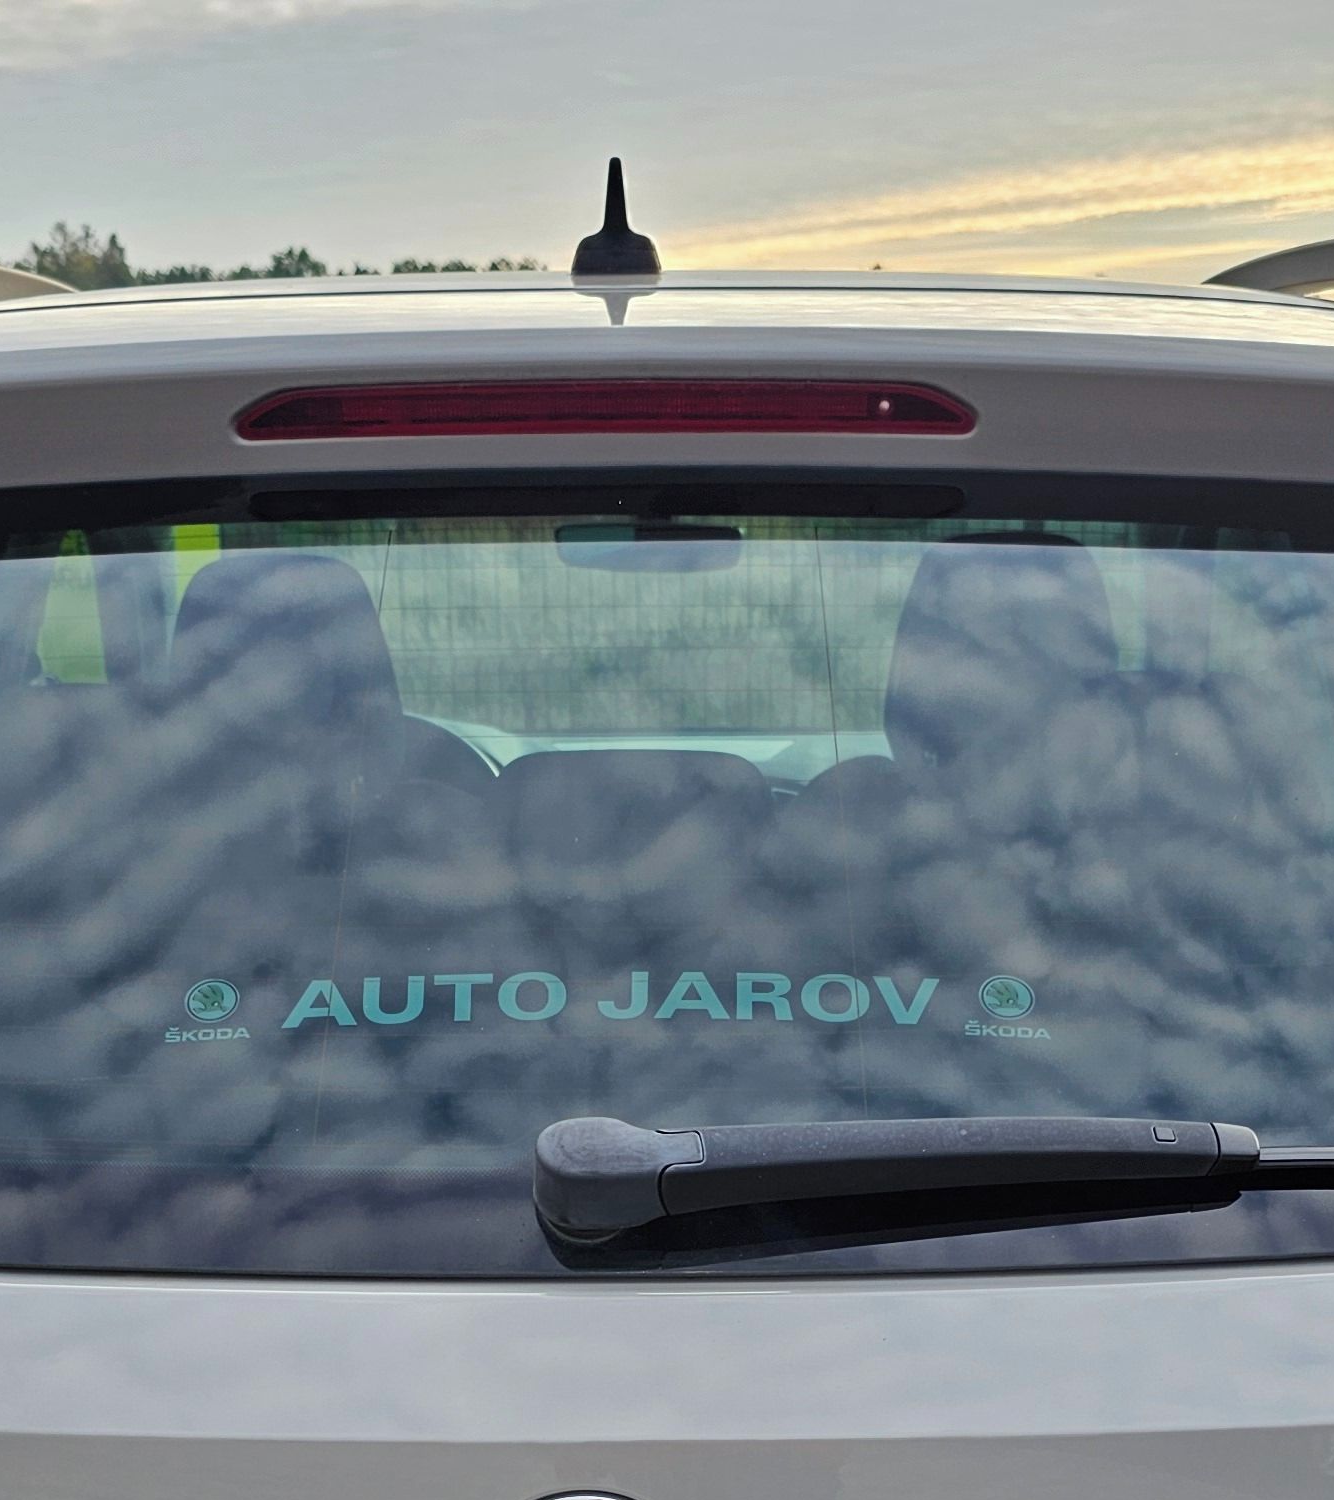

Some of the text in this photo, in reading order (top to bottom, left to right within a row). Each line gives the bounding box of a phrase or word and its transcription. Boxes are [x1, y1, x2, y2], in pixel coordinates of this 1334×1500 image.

[281, 971, 940, 1029] AUTO JAROV
[164, 1026, 251, 1043] ŠKODA
[964, 1020, 1051, 1040] ŠKODA
